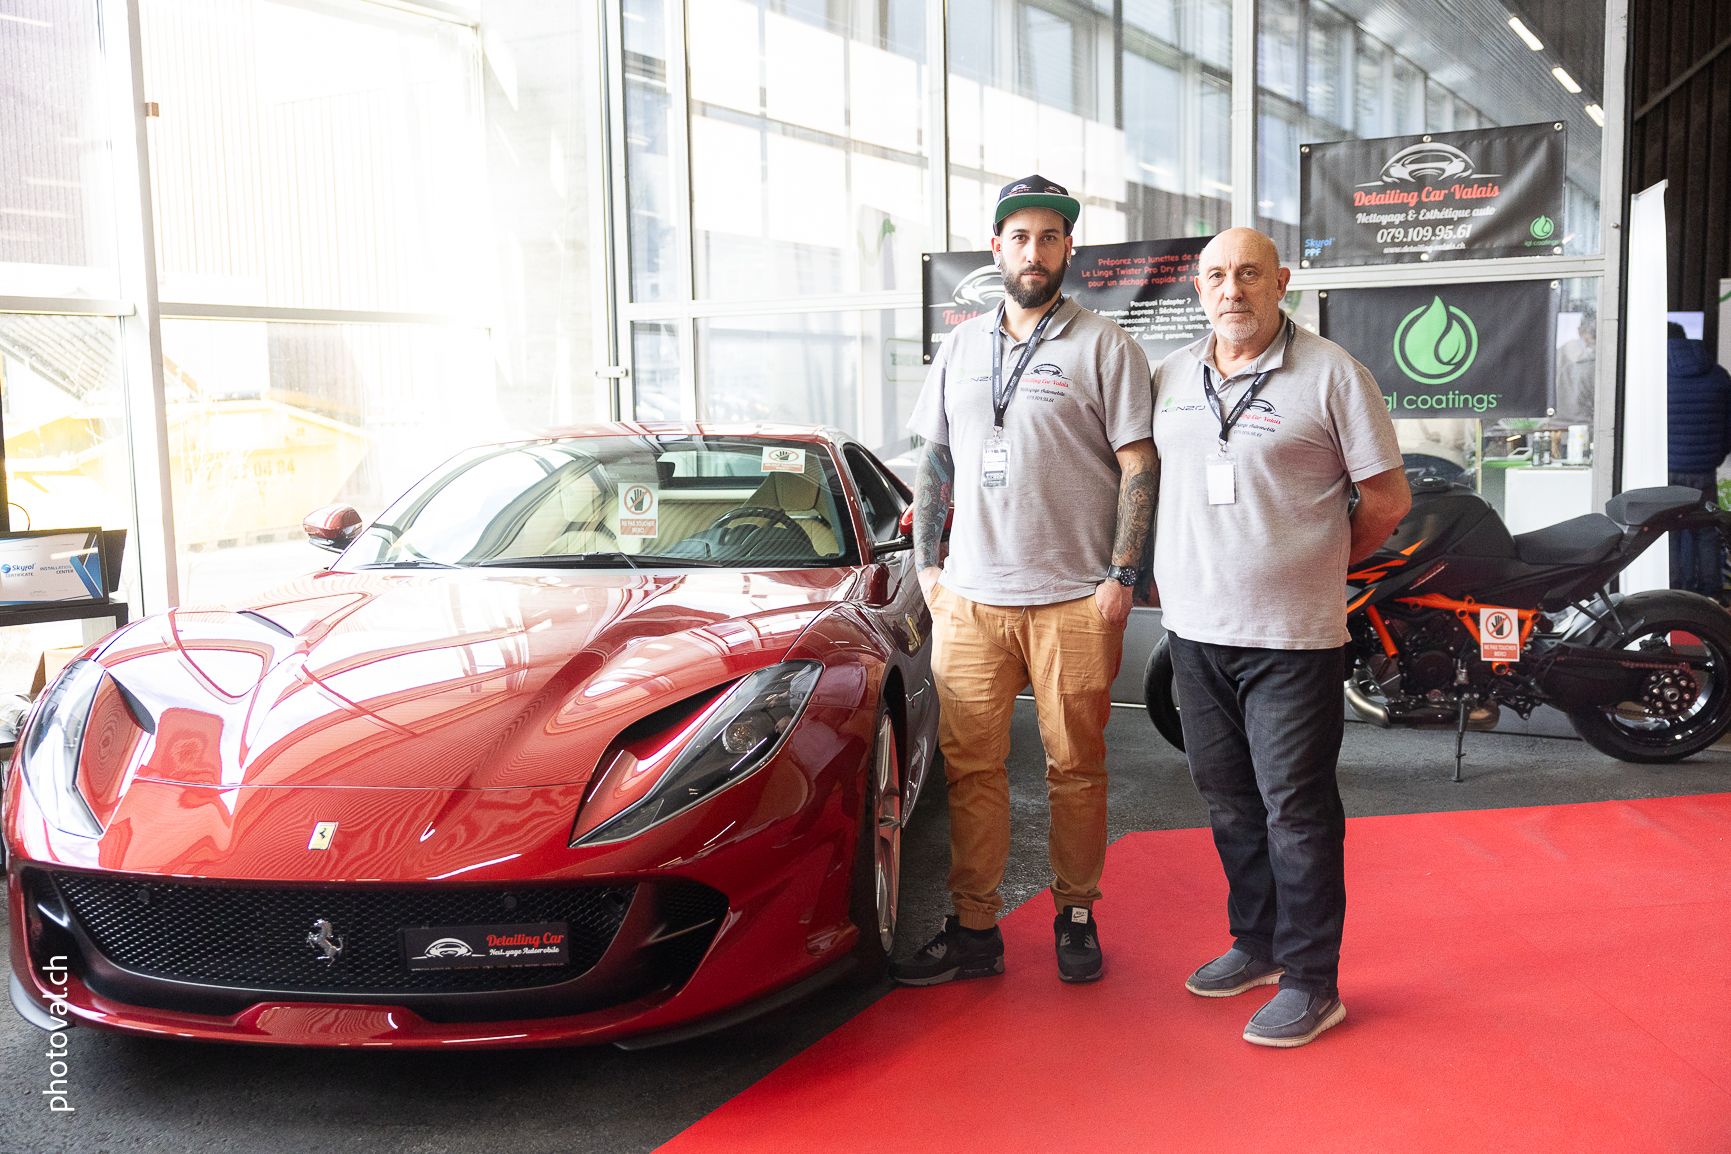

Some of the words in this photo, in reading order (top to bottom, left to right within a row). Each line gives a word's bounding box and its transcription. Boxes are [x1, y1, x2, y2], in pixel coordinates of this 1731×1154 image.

[1353, 189, 1418, 207] Detailing
[1421, 186, 1448, 202] Car
[1450, 183, 1500, 199] Valais
[1355, 212, 1406, 225] Nettoyage
[1407, 210, 1417, 221] &
[1418, 207, 1471, 221] Esthétique
[1472, 206, 1496, 217] auto
[1376, 224, 1473, 244] 079.109.95.61
[1304, 248, 1322, 257] PPF
[1098, 258, 1131, 266] Préparez
[1148, 255, 1179, 263] lunettes
[1081, 270, 1090, 278] Le
[1092, 269, 1113, 278] Linge
[1116, 267, 1142, 275] Twister
[1144, 266, 1158, 274] Pro
[1160, 265, 1175, 274] Dry
[1087, 280, 1105, 288] pour
[1119, 278, 1149, 287] séchage
[1151, 276, 1177, 285] rapide
[1130, 299, 1158, 308] Pourquoi
[1187, 297, 1192, 305] ?
[1131, 308, 1154, 317] express
[1159, 307, 1185, 315] Séchage
[1155, 315, 1171, 323] Zéro
[1151, 323, 1177, 332] Préserve
[1142, 333, 1164, 341] Qualité
[1053, 380, 1070, 388] Valais
[1403, 390, 1497, 412] coatings
[1264, 416, 1281, 425] Valais
[486, 933, 541, 948] Detailing
[542, 932, 565, 944] Car
